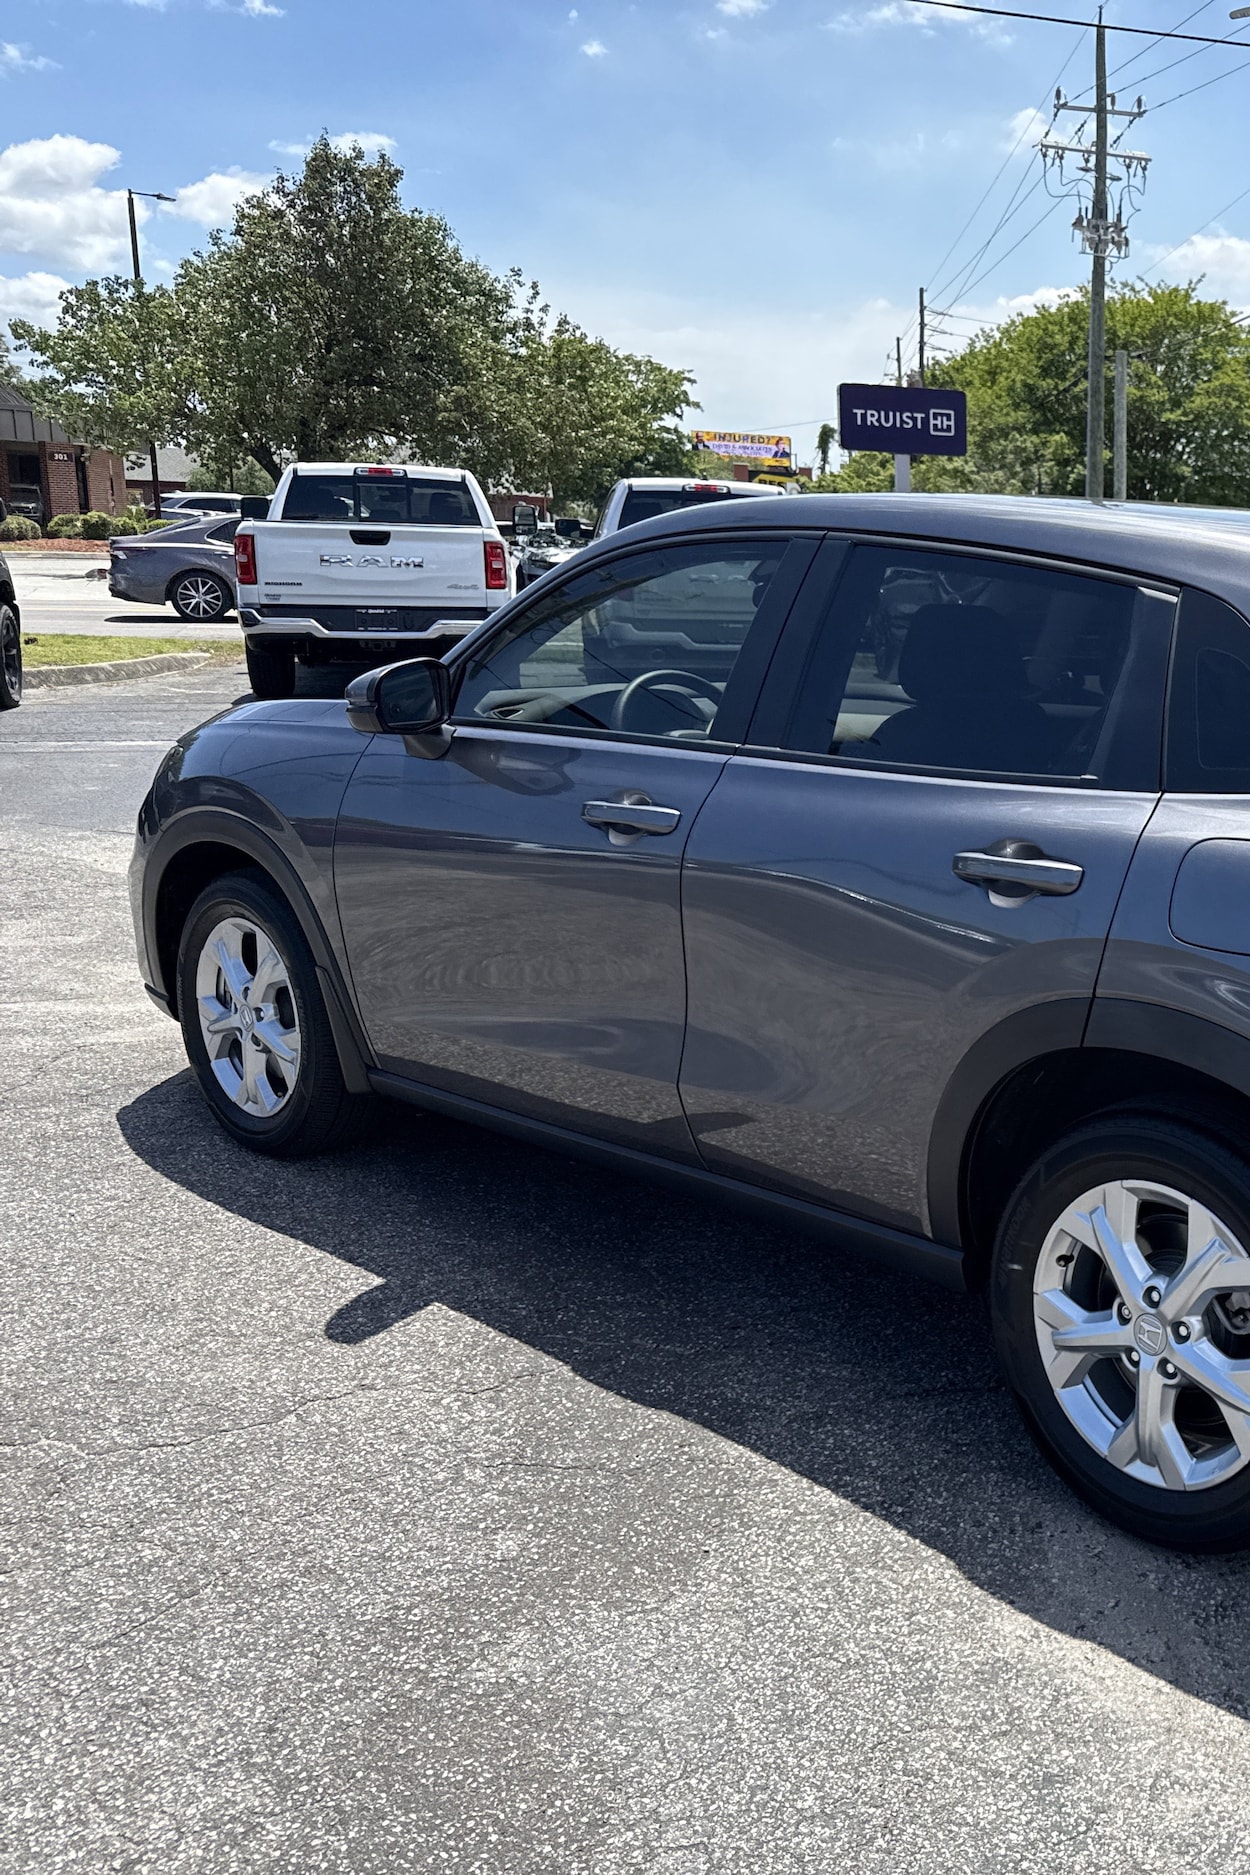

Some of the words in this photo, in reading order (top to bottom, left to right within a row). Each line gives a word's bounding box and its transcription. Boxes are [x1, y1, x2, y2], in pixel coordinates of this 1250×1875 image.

[852, 408, 926, 430] TRUIST
[714, 432, 771, 445] INJURED?
[320, 554, 424, 568] RAM
